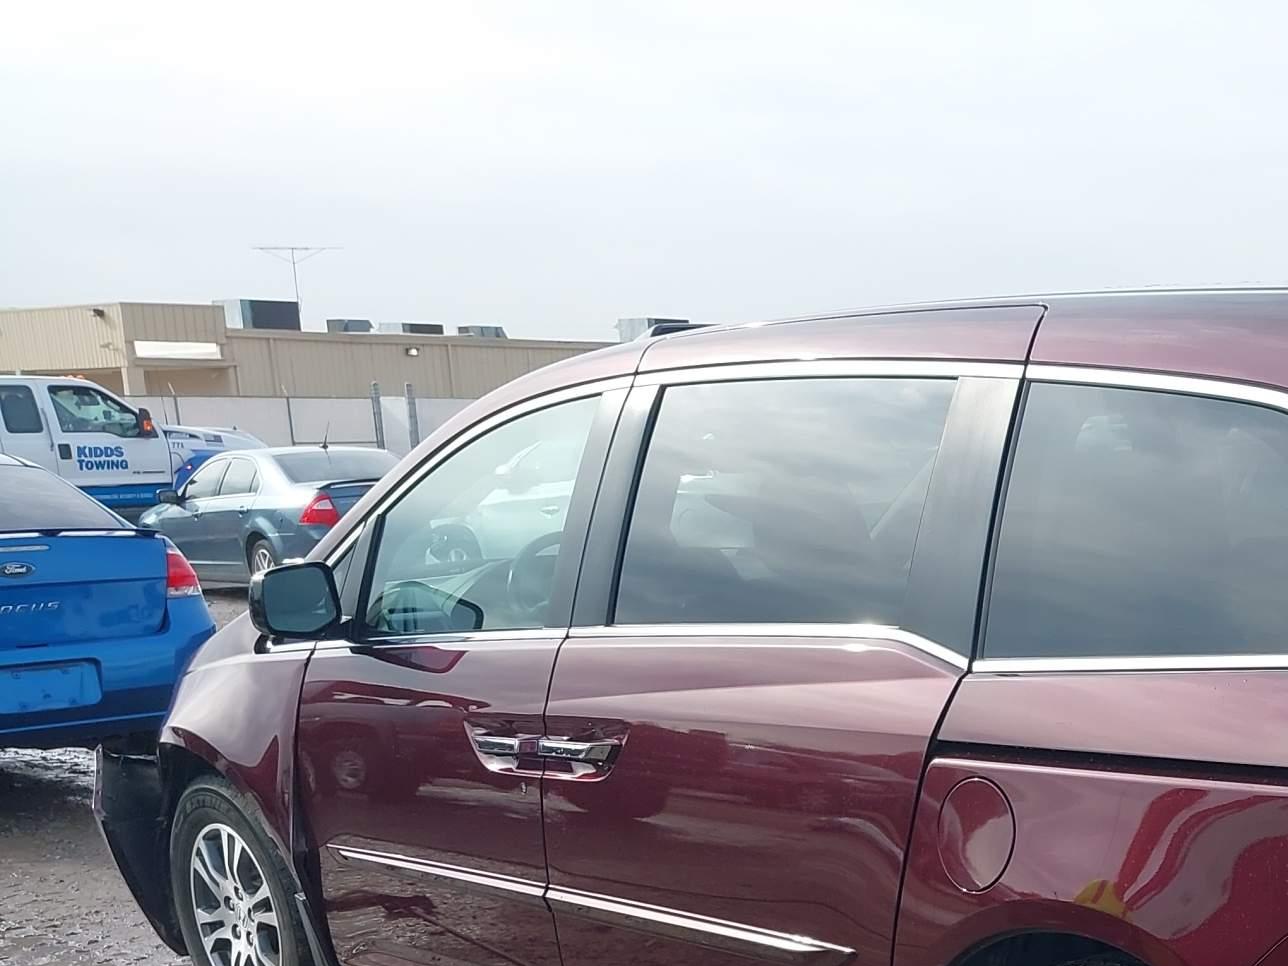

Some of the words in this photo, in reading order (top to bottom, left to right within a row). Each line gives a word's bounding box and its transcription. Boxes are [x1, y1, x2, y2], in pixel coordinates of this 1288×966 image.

[76, 446, 125, 458] KIDDS
[77, 459, 129, 471] TOWING
[4, 564, 27, 574] Ford
[0, 601, 60, 614] OCUS
